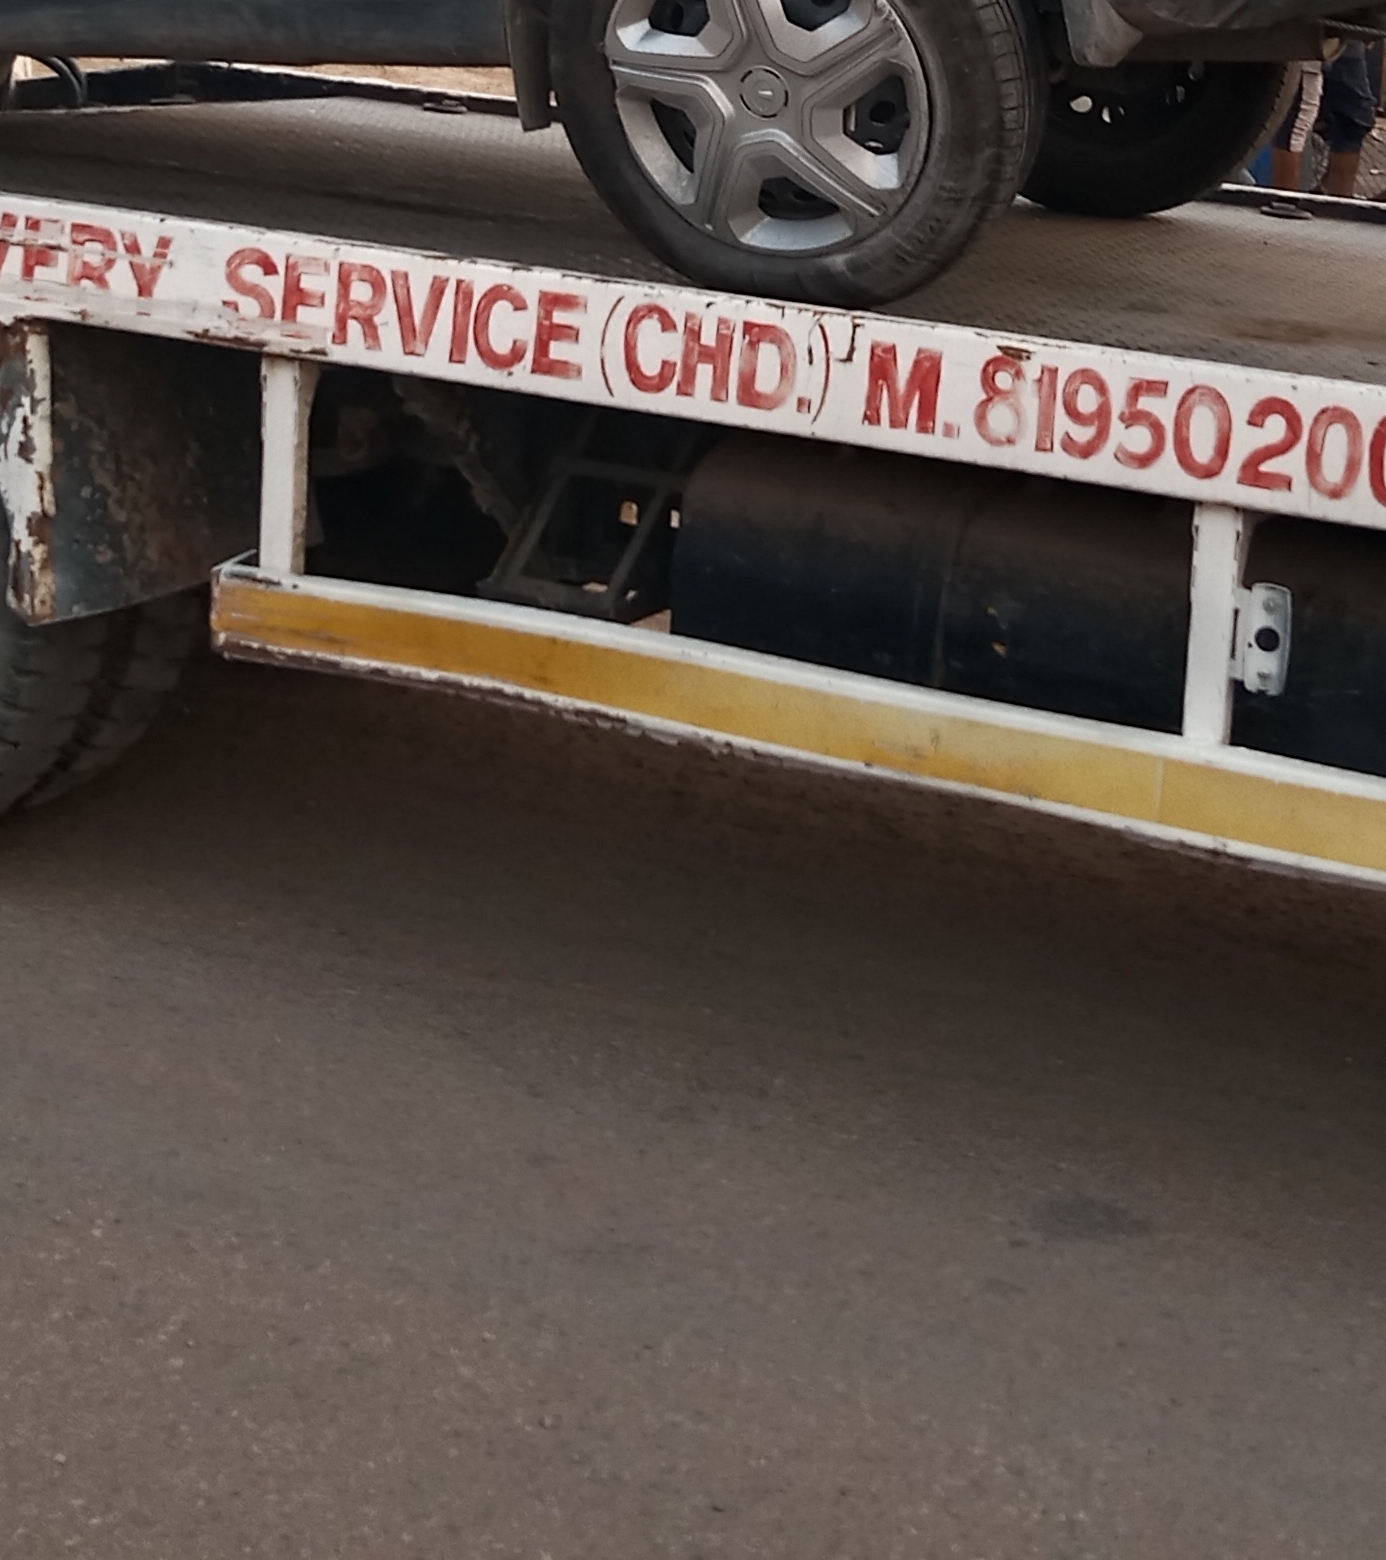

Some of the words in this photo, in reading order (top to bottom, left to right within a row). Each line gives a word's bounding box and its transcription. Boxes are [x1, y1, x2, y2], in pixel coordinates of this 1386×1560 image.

[221, 246, 588, 382] SERVICE
[599, 295, 831, 425] (CHD.)
[862, 339, 961, 438] M.
